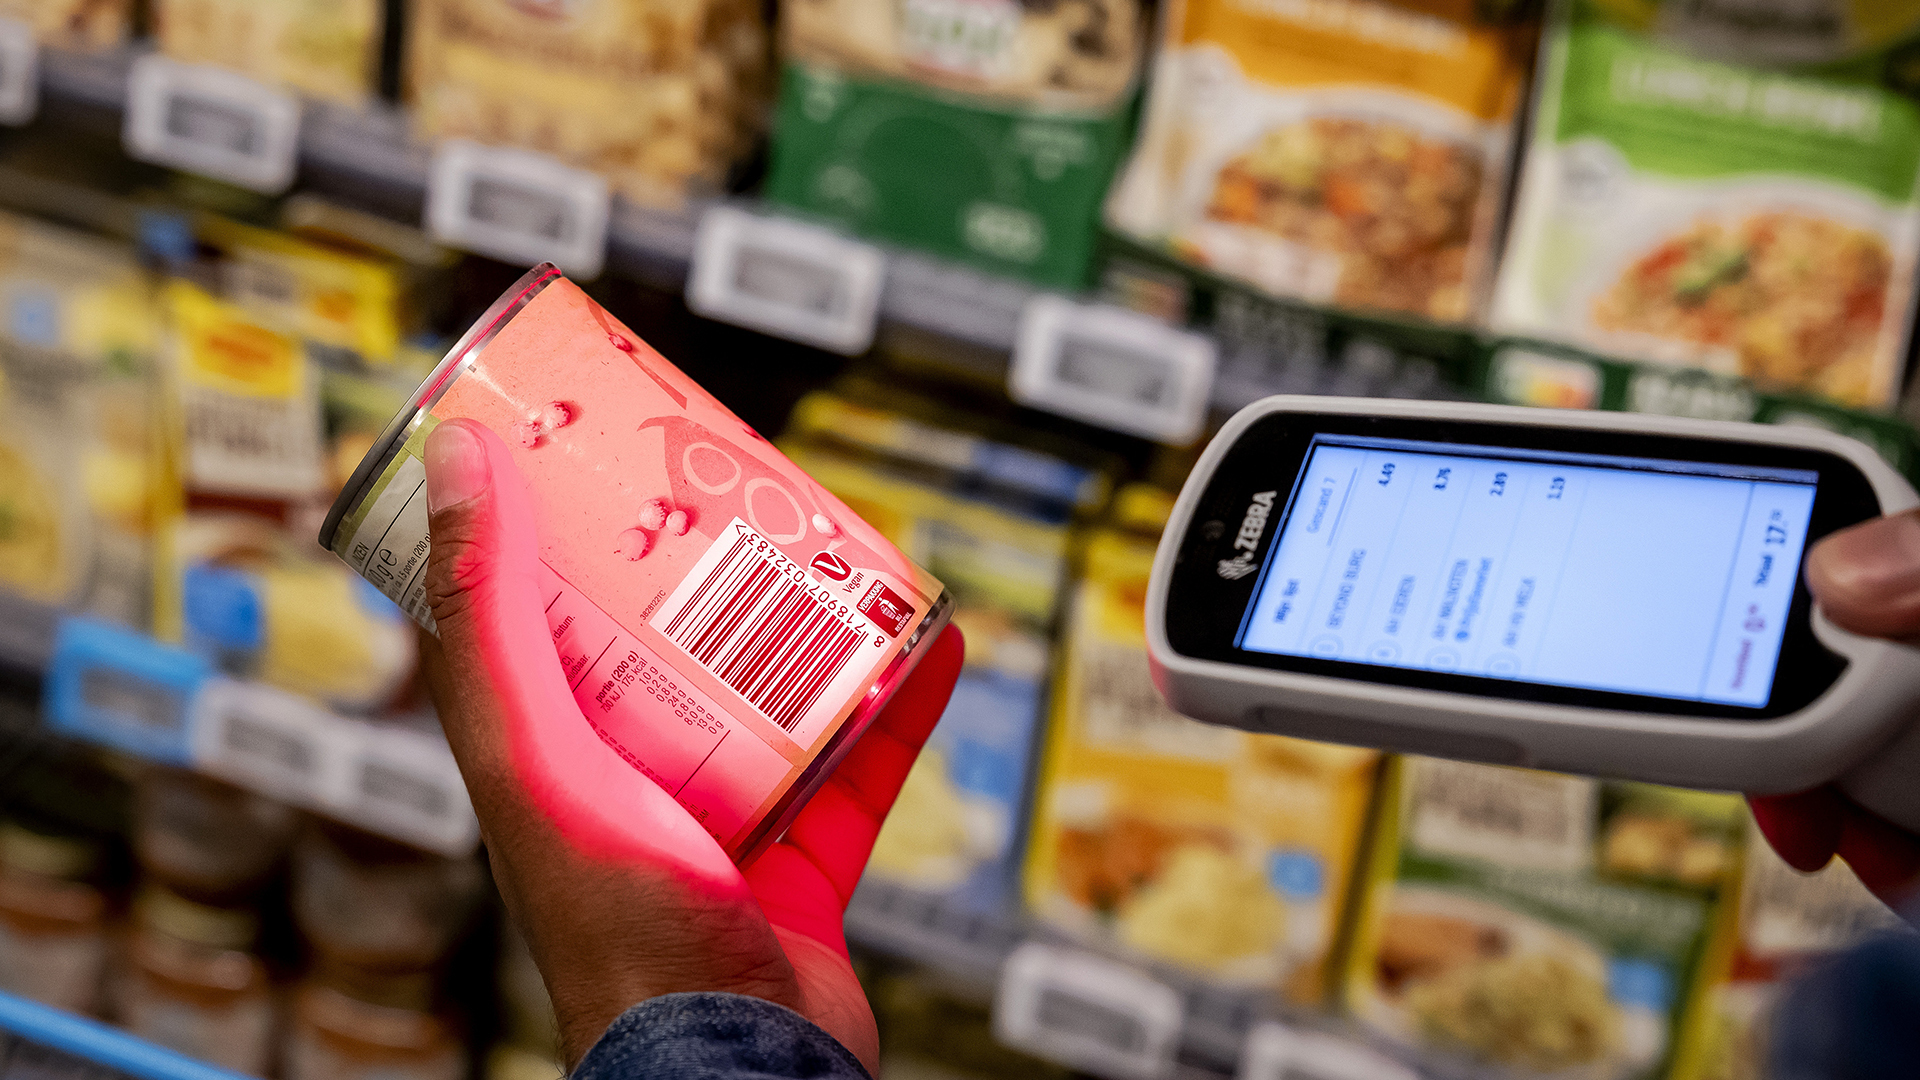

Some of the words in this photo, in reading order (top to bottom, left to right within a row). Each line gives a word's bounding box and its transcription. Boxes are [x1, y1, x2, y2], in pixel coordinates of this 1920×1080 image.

[1234, 490, 1277, 551] ZEBRA
[404, 556, 418, 578] portie
[413, 540, 428, 560] (200
[842, 572, 865, 594] Vegan
[808, 585, 866, 634] 718907
[554, 614, 576, 640] datum.
[873, 635, 885, 648] 8
[566, 654, 591, 684] oudbaar.
[596, 679, 615, 704] portie
[611, 660, 630, 682] (200
[627, 650, 640, 664] g)
[638, 671, 652, 686] 1,0
[649, 665, 659, 676] g
[600, 699, 615, 714] 730
[611, 691, 621, 703] kJ
[621, 672, 636, 688] 175
[631, 657, 648, 676] kcal
[646, 679, 662, 696] 0,2
[659, 673, 668, 683] g
[655, 686, 671, 703] 0,8
[668, 682, 678, 691] g
[667, 695, 680, 708] 24
[678, 689, 687, 699] g
[674, 703, 689, 718] 0,8
[686, 698, 696, 707] g
[684, 710, 699, 726] 8,0
[696, 704, 706, 714] g
[696, 718, 708, 730] 13
[706, 712, 715, 722] g
[708, 726, 718, 735] 0
[715, 720, 724, 730] g
